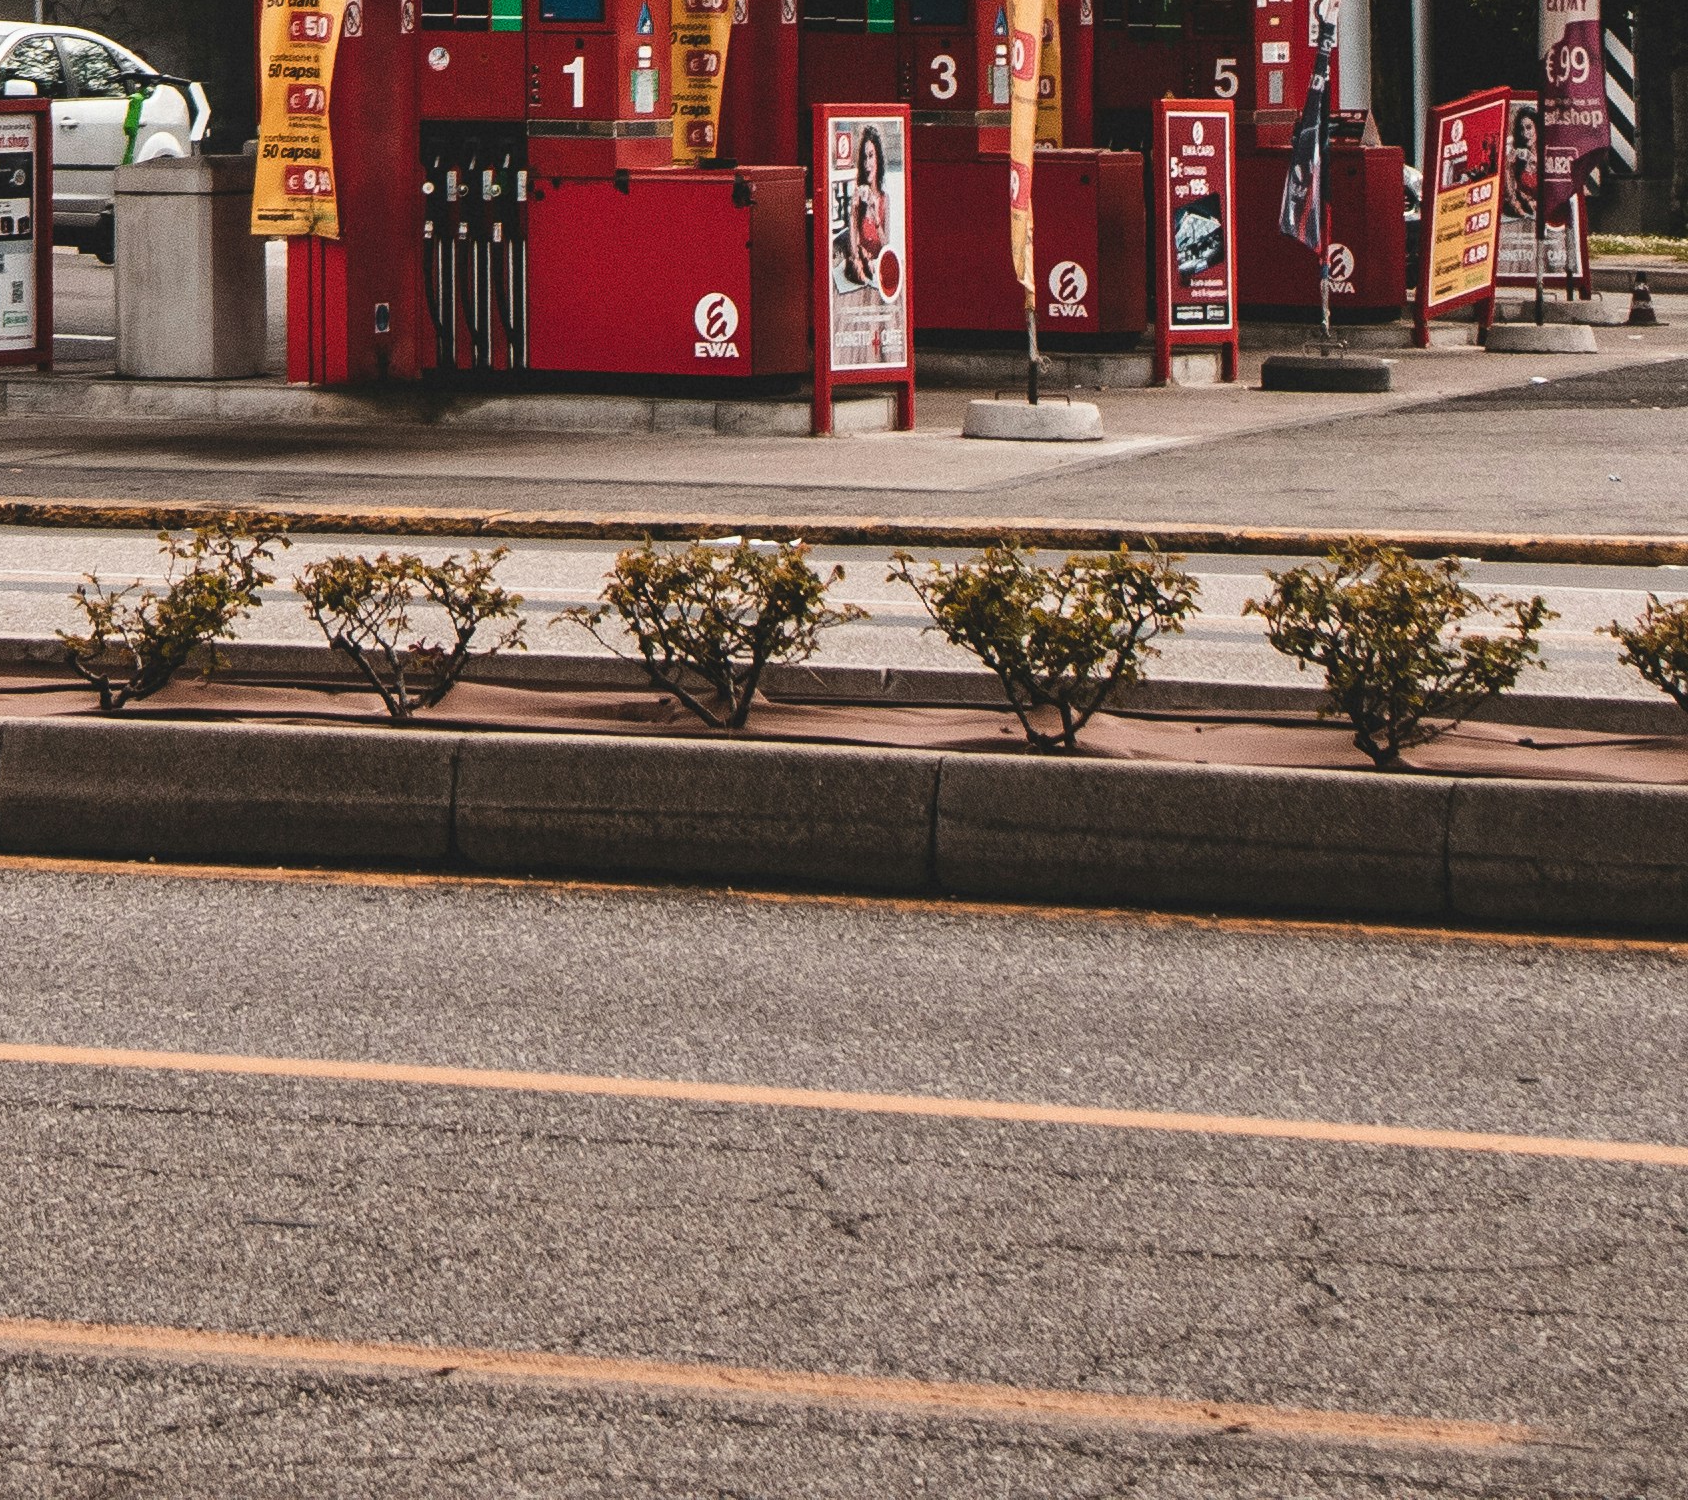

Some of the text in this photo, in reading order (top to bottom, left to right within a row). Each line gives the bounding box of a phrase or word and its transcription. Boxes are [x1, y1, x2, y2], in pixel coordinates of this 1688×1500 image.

[562, 56, 585, 108] 1
[929, 54, 958, 100] 3
[1214, 58, 1239, 98] 5
[263, 144, 279, 159] 50
[1048, 302, 1089, 318] EWA
[694, 342, 740, 358] EWA
